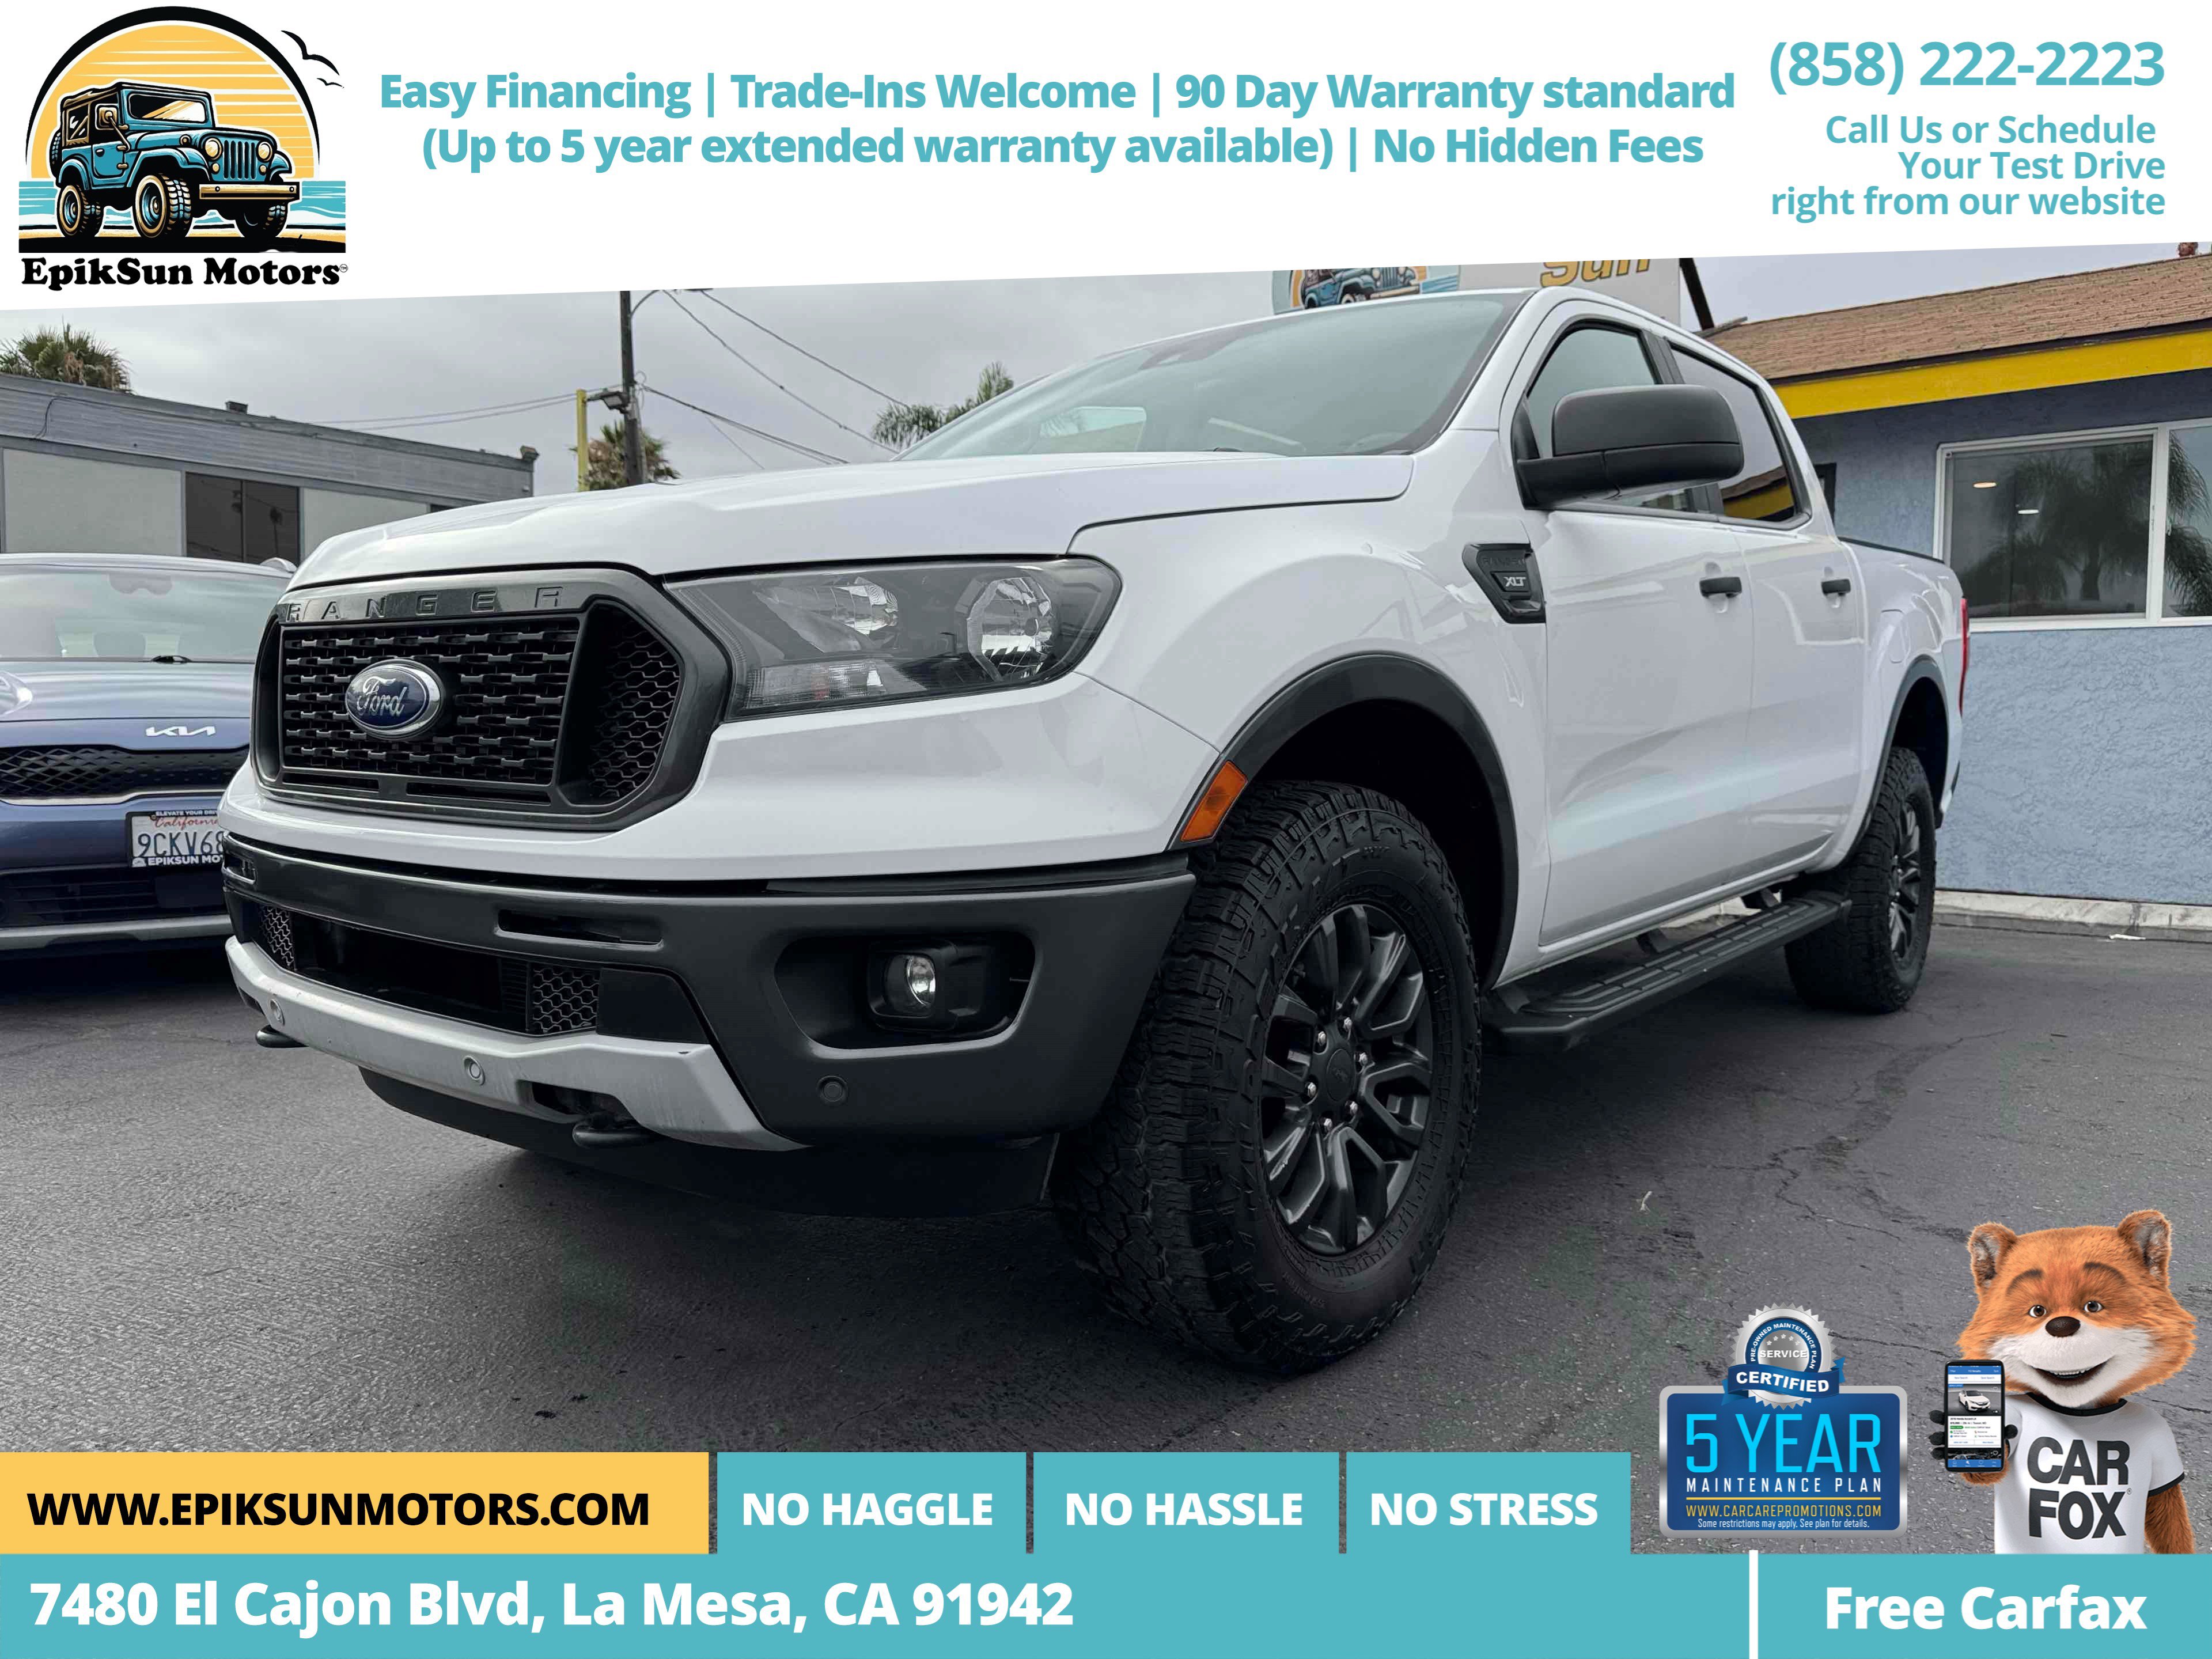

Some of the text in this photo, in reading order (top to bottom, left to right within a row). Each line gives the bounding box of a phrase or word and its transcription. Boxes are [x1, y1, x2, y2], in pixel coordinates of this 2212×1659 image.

[1503, 576, 1526, 587] XLT
[286, 586, 564, 623] RANGER
[355, 675, 407, 718] Ford
[146, 726, 216, 737] KIA
[147, 855, 199, 866] EPIKSUN
